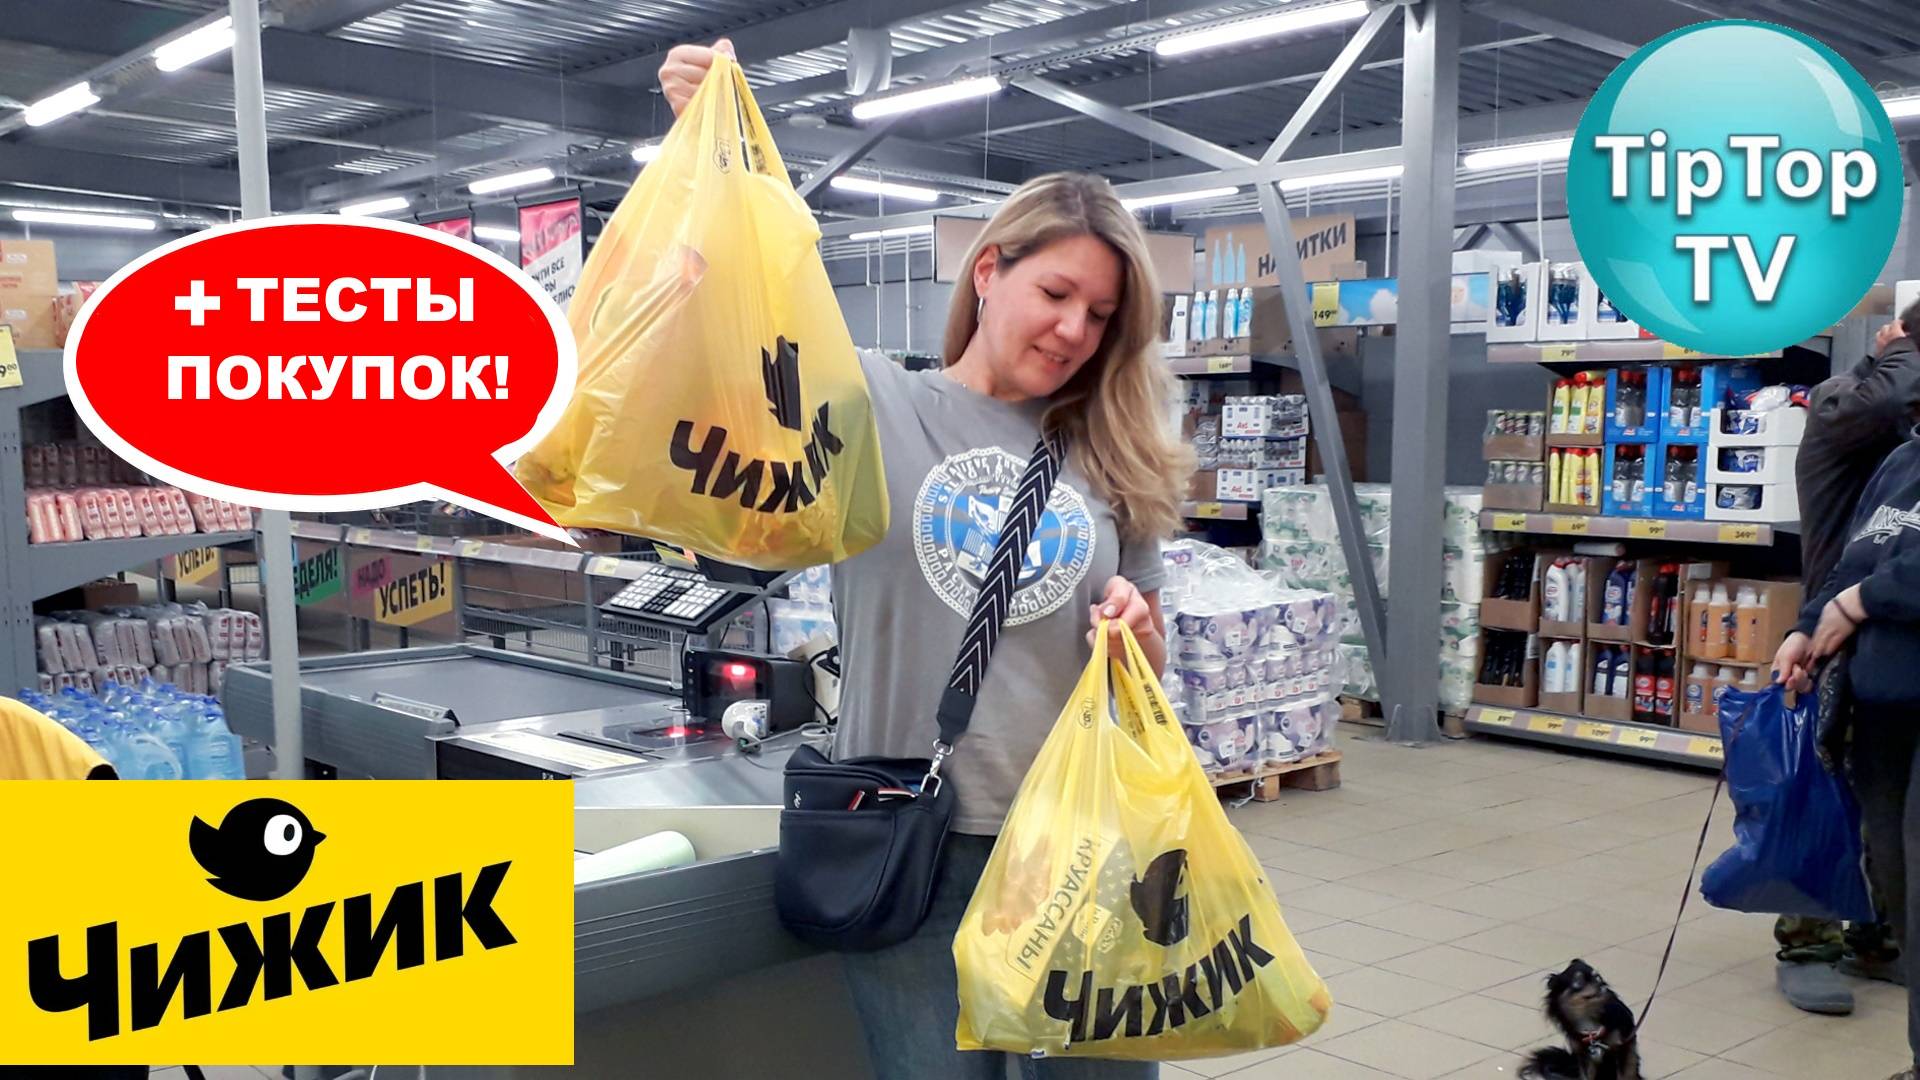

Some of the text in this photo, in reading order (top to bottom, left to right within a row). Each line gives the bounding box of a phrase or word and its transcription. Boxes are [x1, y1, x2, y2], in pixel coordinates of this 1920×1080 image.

[1258, 222, 1346, 278] НИТКИ
[379, 562, 445, 619] УСПЕТЬ!
[1016, 837, 1093, 970] КРУАССАНЫ
